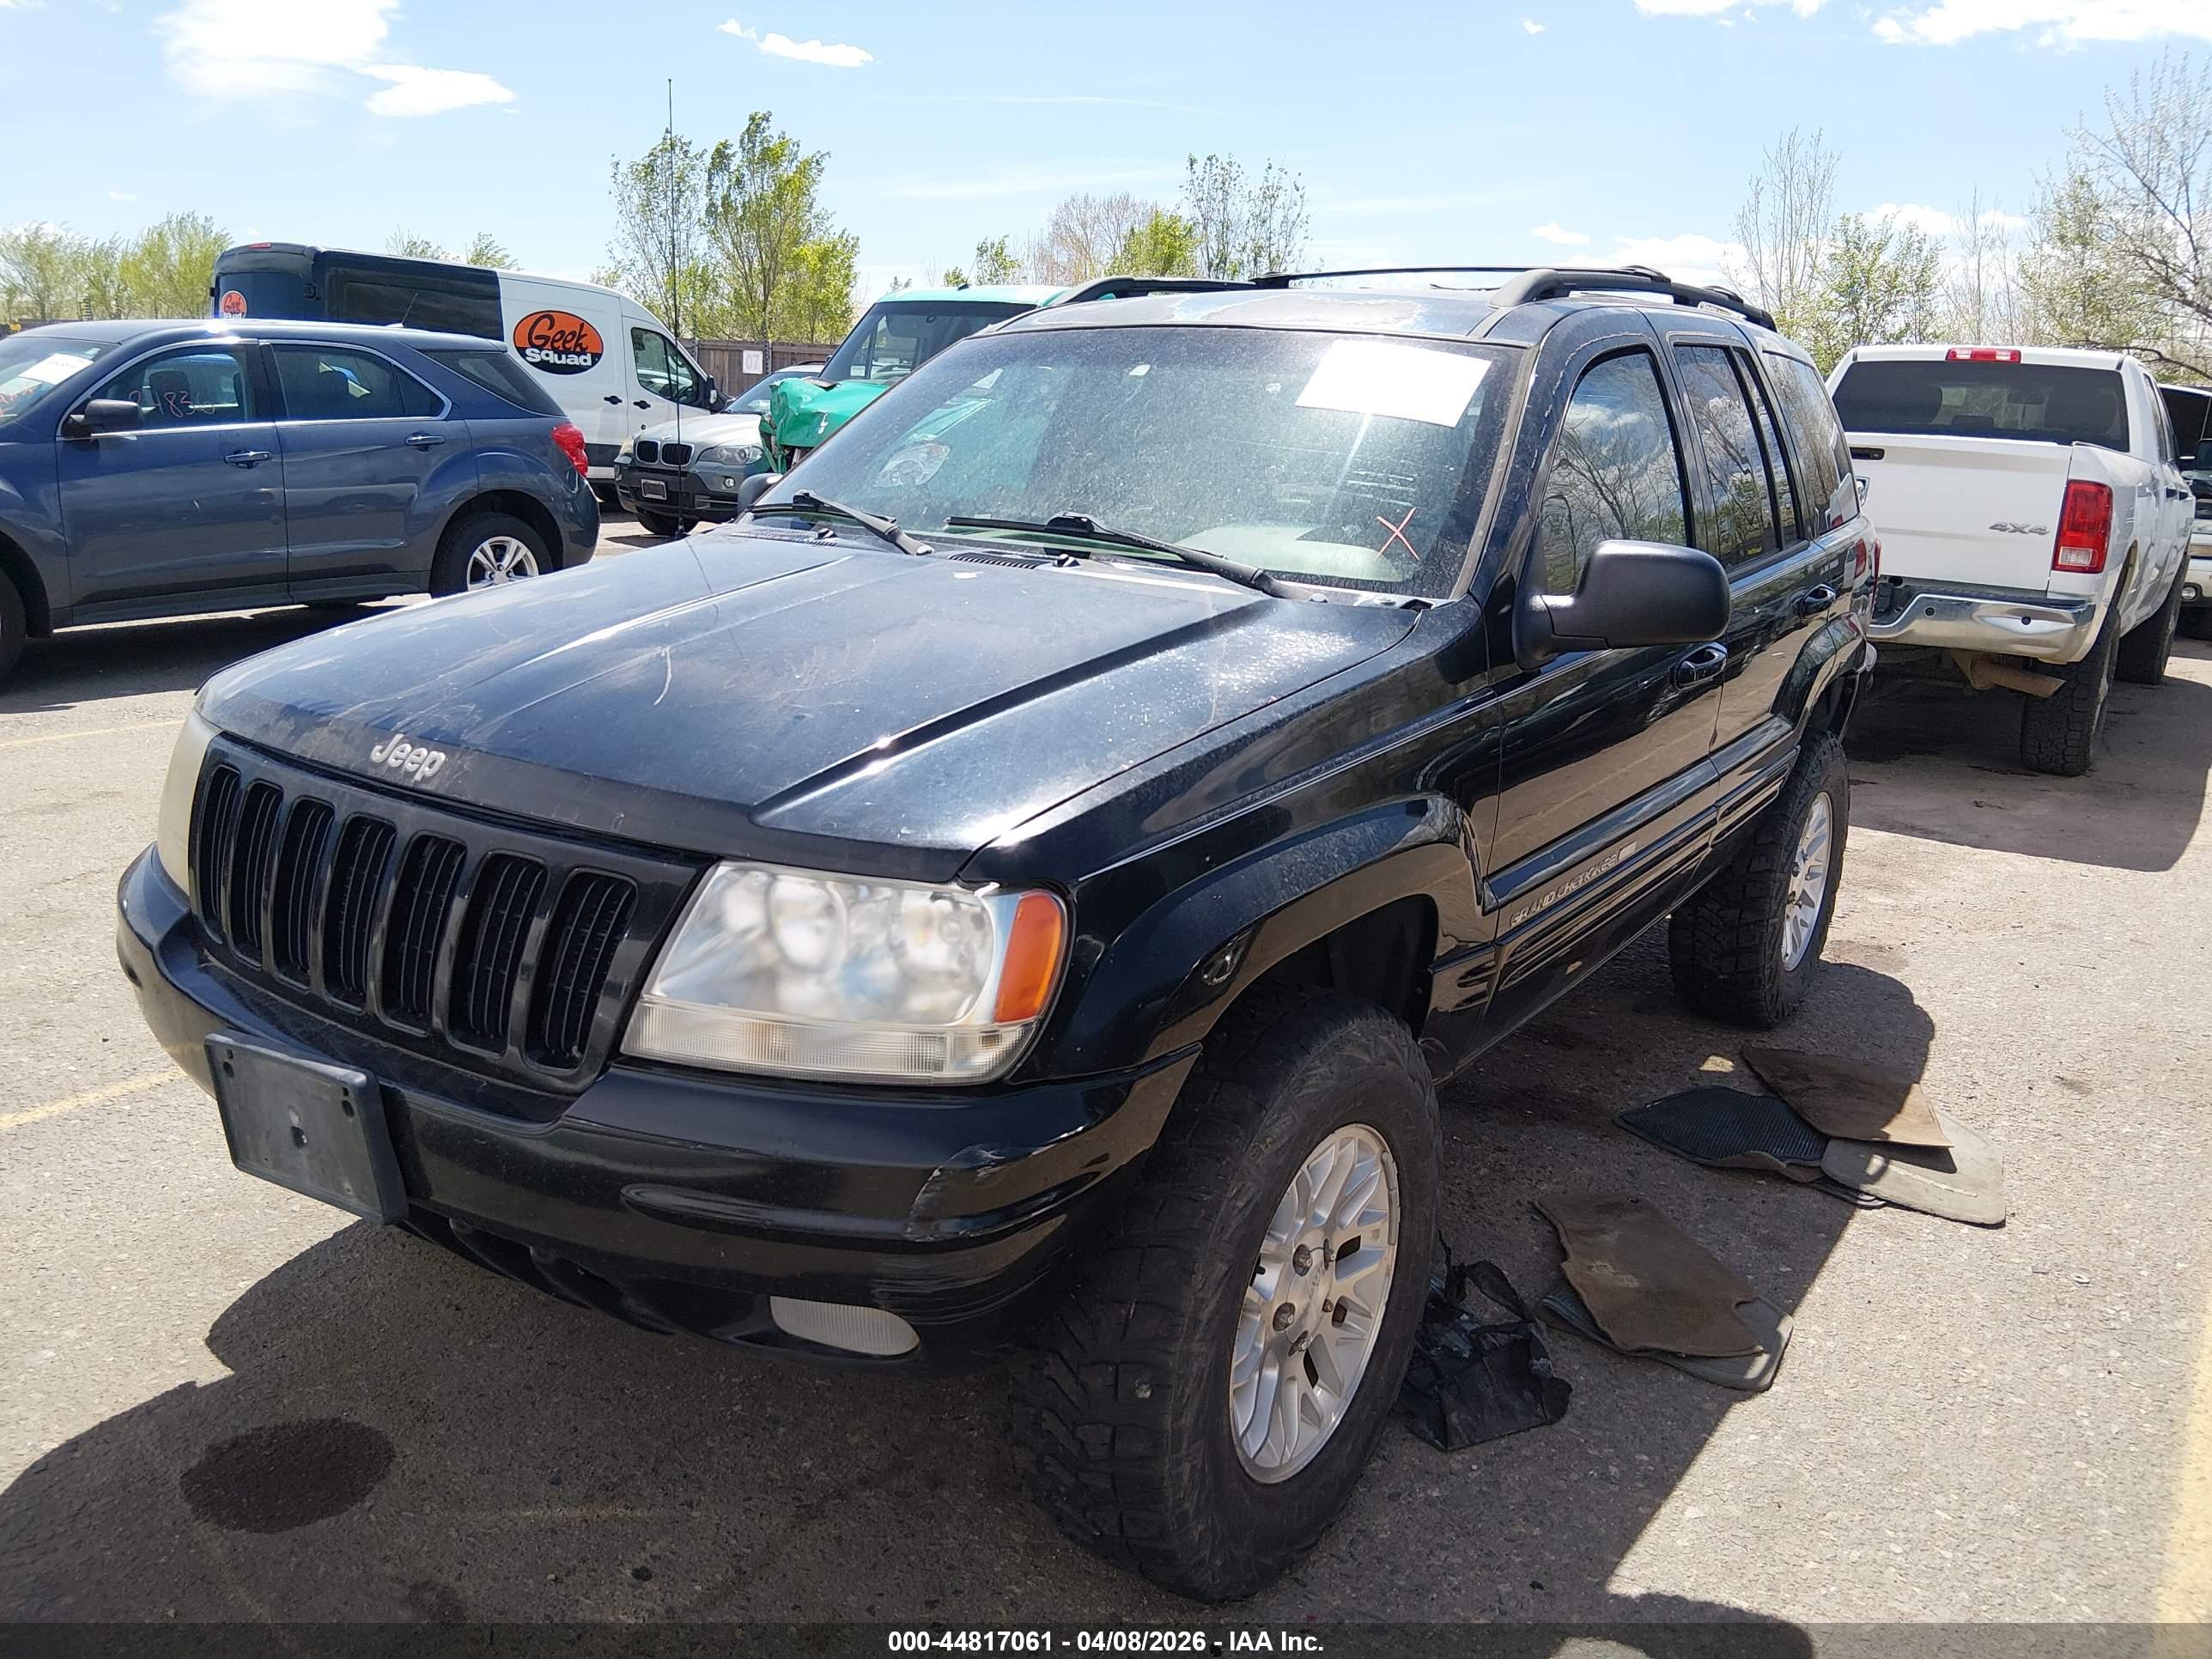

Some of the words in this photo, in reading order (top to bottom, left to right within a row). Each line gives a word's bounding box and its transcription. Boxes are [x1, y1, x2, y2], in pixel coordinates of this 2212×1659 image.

[527, 313, 588, 353] Geek
[370, 733, 447, 782] Jeep
[1510, 890, 1556, 927] GRAND
[1557, 854, 1616, 899] CHEROKEE
